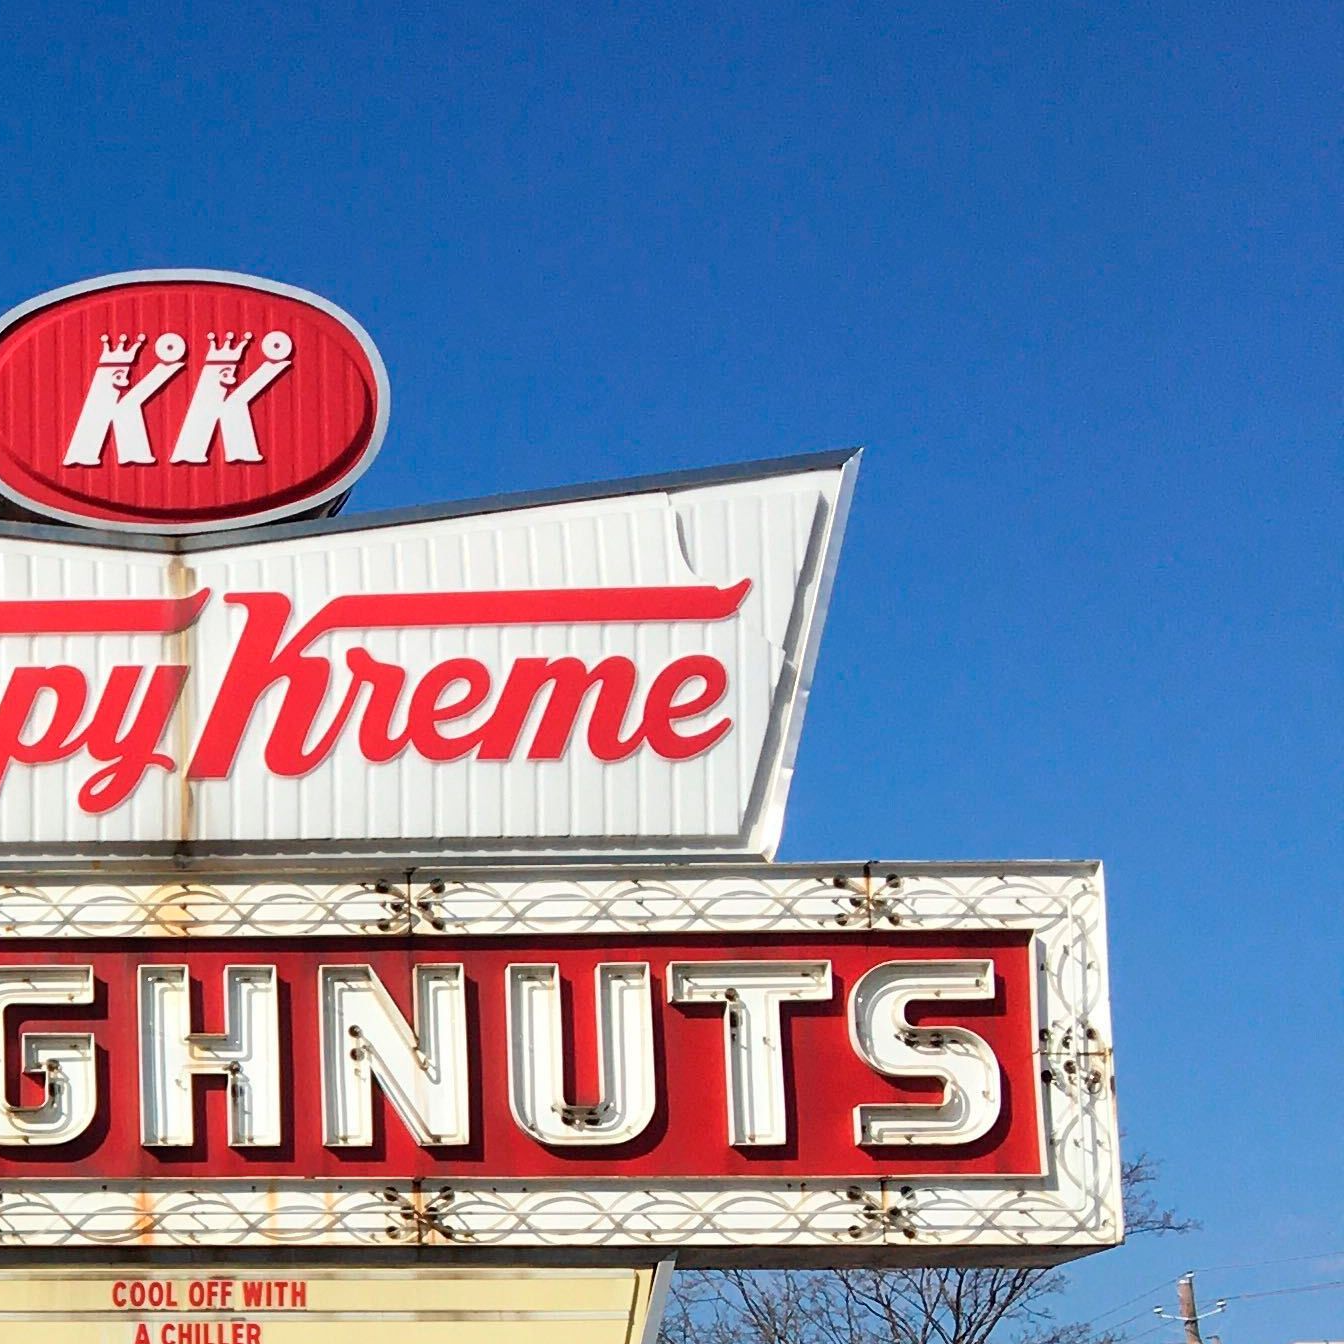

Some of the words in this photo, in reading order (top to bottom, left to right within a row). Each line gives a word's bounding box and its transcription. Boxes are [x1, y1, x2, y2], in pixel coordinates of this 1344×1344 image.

[185, 576, 753, 782] Kreme
[112, 1281, 178, 1307] COOL
[188, 1281, 233, 1307] OFF
[242, 1281, 307, 1307] WITH
